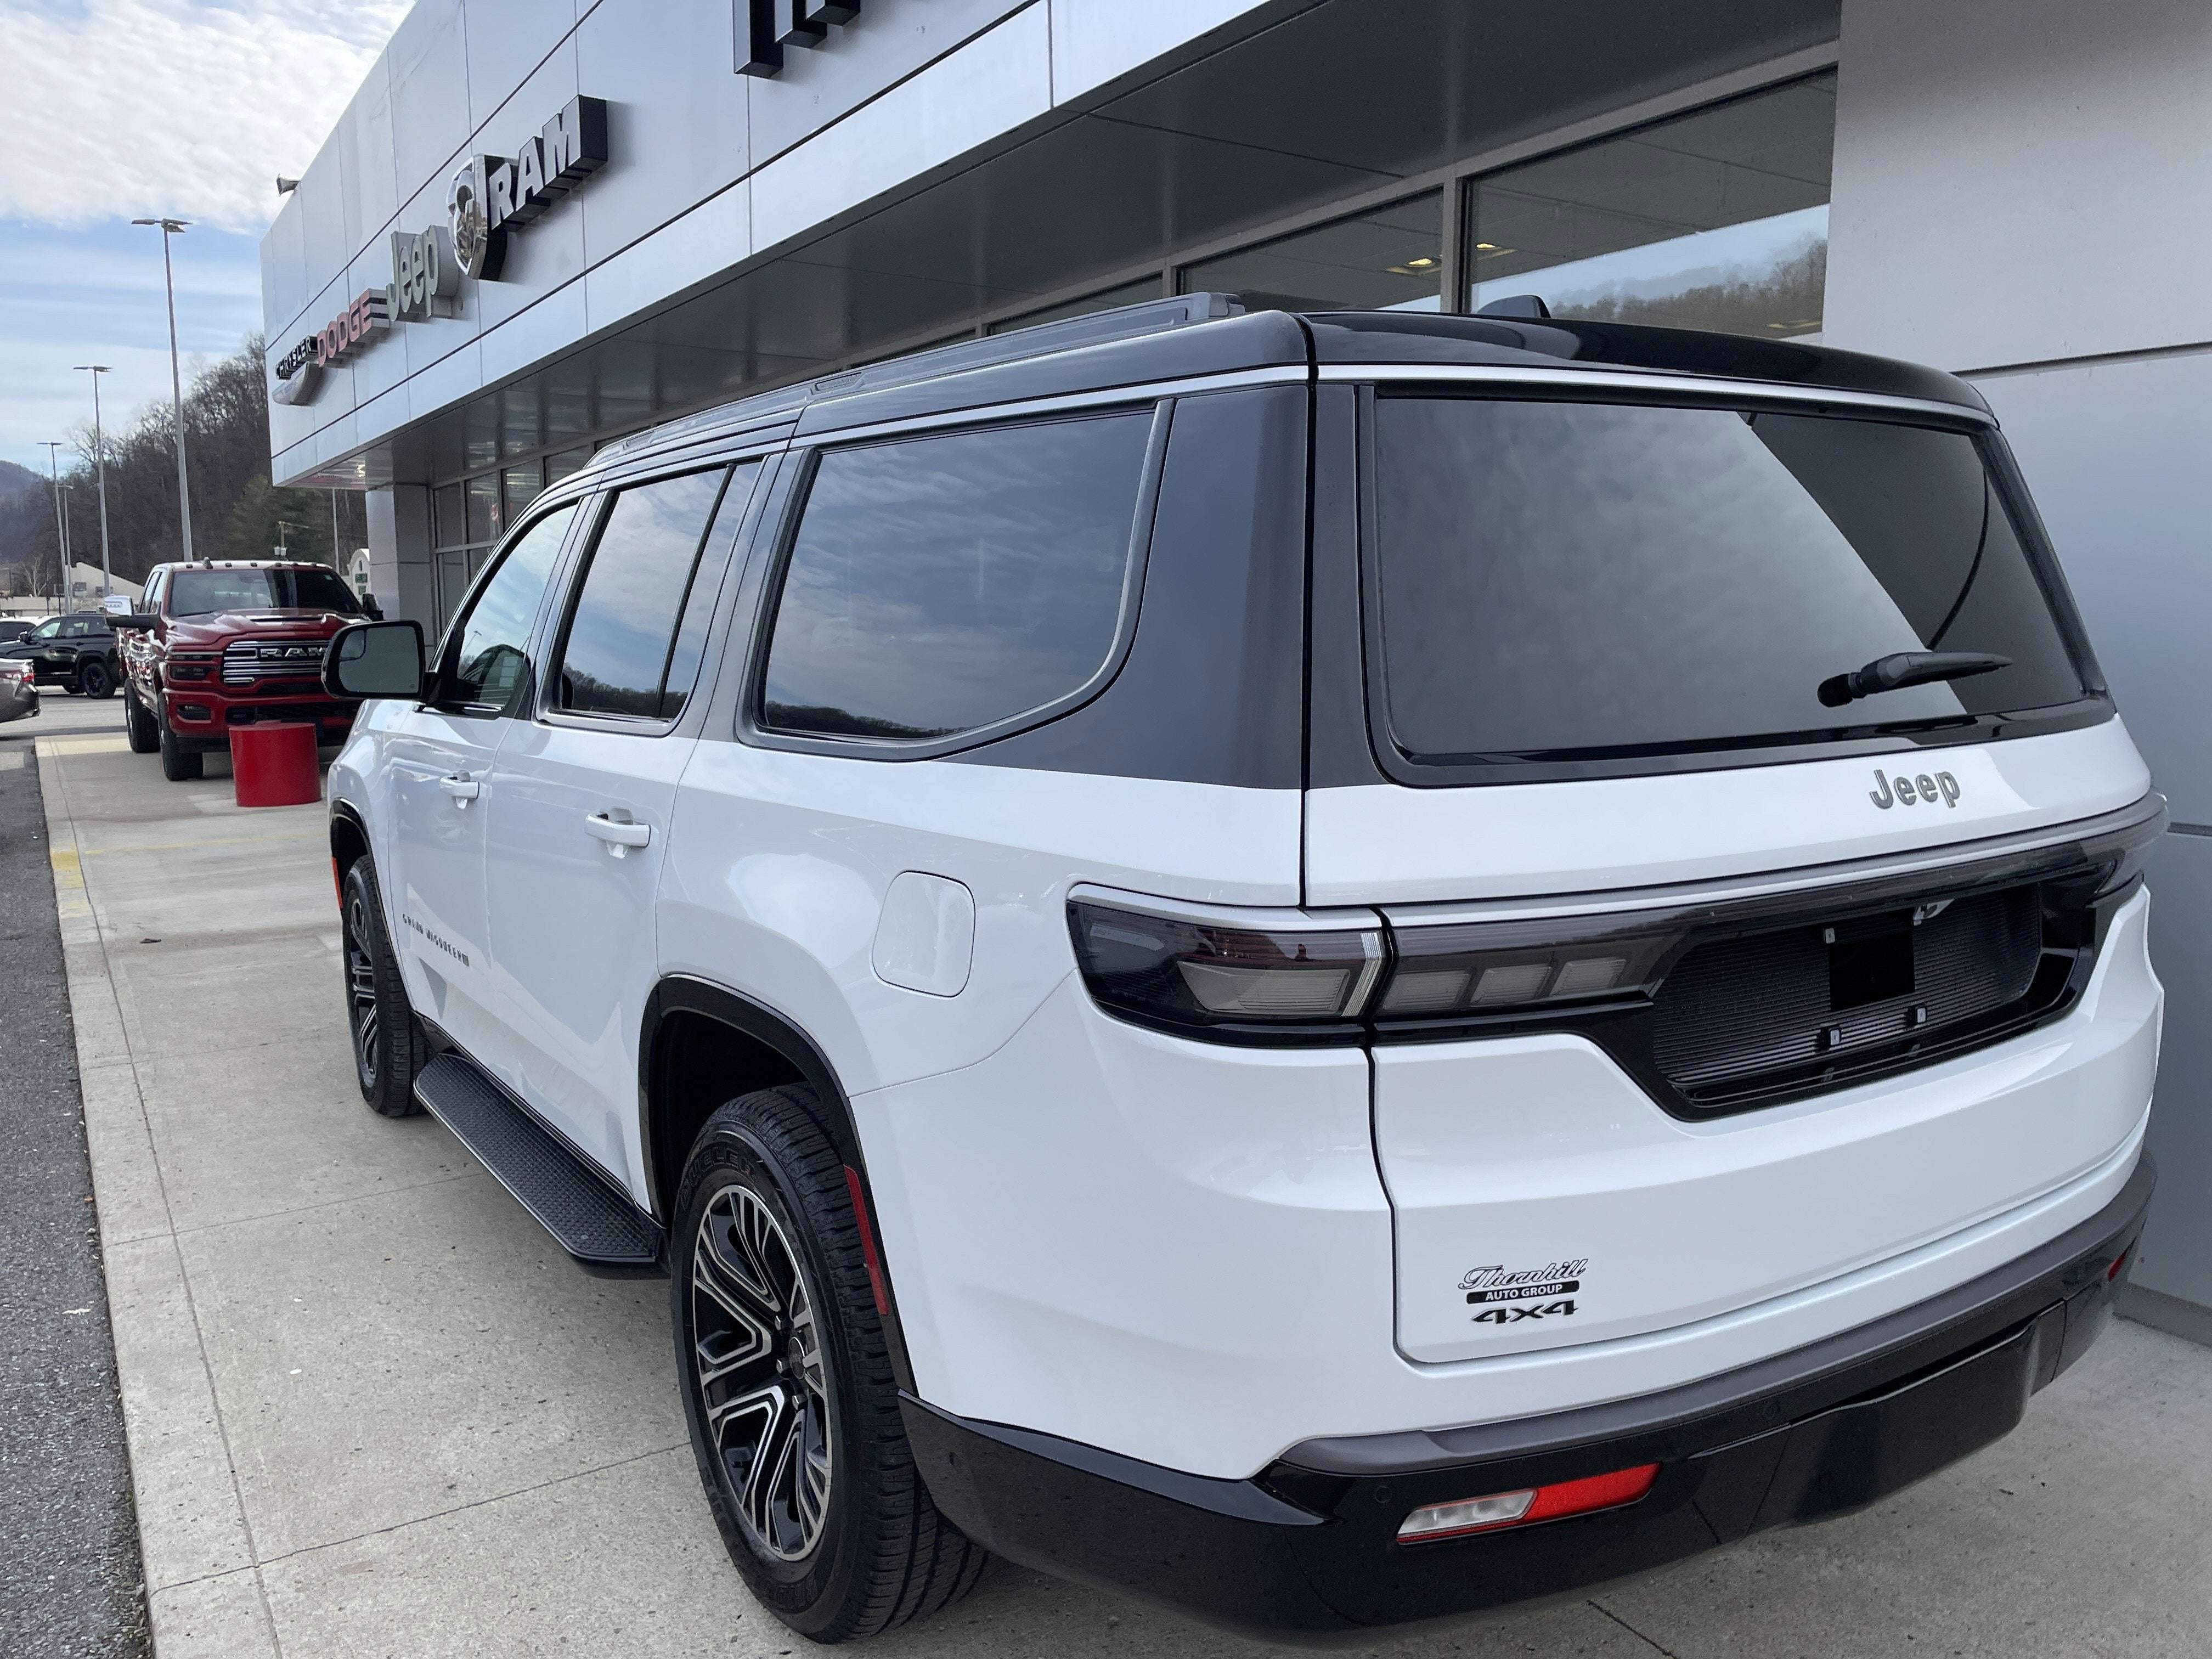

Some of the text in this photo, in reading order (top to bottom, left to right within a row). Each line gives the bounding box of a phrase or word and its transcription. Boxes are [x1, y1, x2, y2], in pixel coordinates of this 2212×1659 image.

[489, 94, 584, 230] RAM
[386, 224, 439, 321] Jeep
[317, 289, 372, 368] DODGE
[275, 335, 315, 380] CHRYSLER
[1869, 769, 1960, 809] Jeep
[1458, 1258, 1588, 1290] Thornhill
[1485, 1284, 1563, 1301] AUTO GROUP
